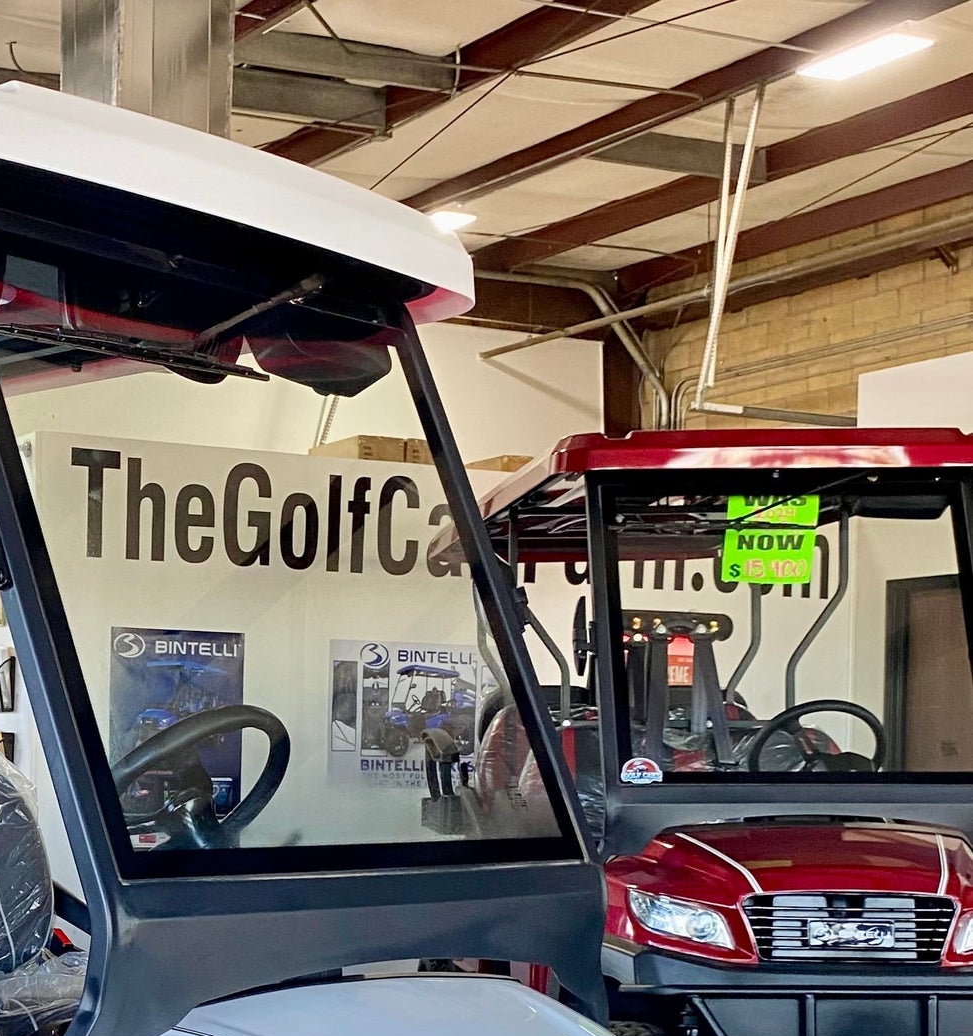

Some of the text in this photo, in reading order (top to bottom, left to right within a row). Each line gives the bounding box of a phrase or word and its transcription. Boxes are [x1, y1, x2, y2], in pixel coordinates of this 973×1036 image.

[737, 535, 805, 550] NOW
[154, 640, 238, 657] BINTELLI
[397, 649, 472, 665] BINTELLI
[360, 759, 424, 772] BINTELLI
